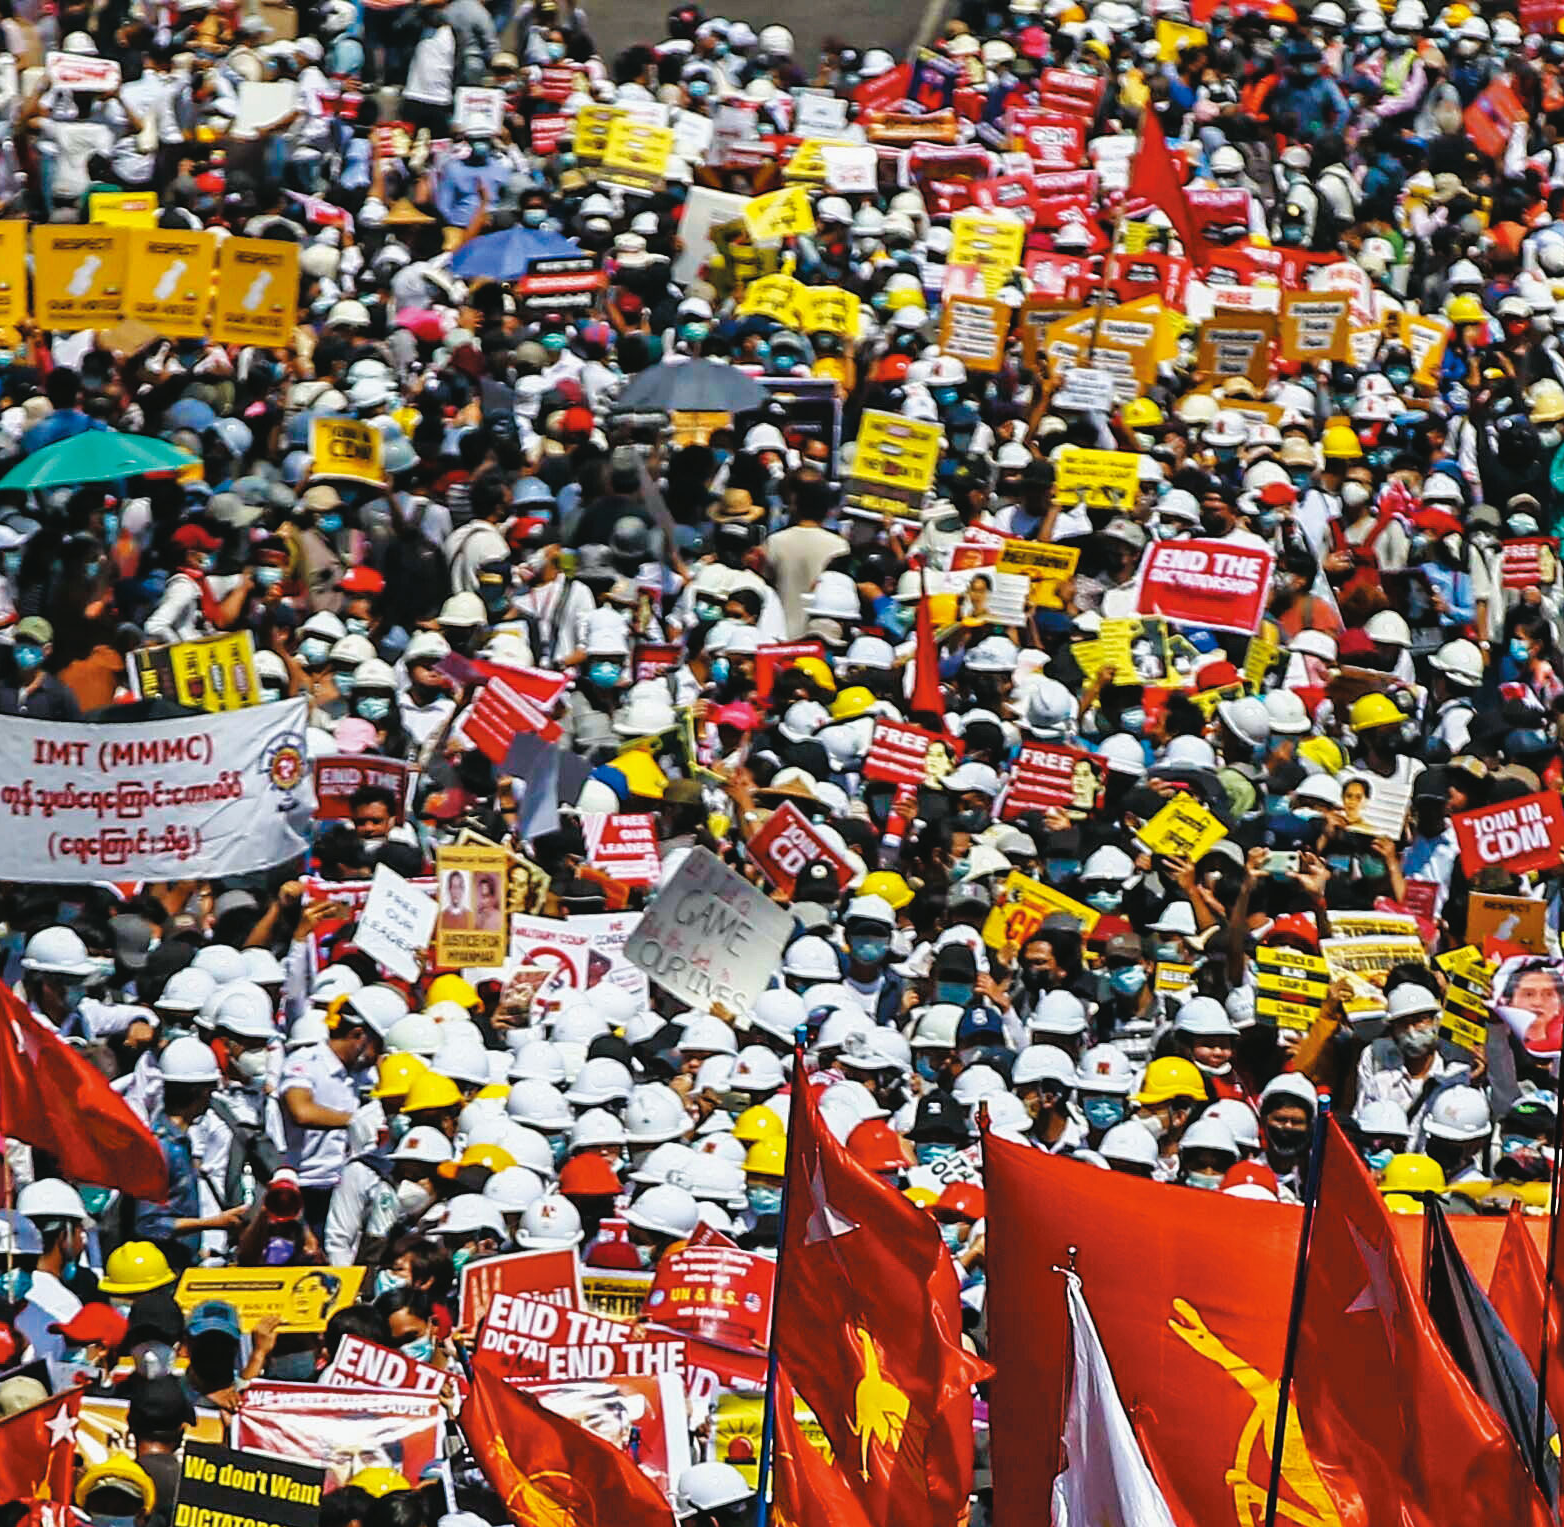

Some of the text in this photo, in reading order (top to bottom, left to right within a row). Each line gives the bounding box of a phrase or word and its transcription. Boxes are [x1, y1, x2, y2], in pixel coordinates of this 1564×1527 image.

[1154, 548, 1262, 581] END THE
[33, 732, 214, 773] IMT (MMMC)
[874, 725, 930, 752] FREE
[1019, 747, 1073, 771] FREE
[319, 767, 363, 785] END
[611, 813, 650, 828] FREE
[1517, 803, 1542, 825] IN
[618, 828, 652, 841] OUR
[1477, 815, 1554, 863] CDM”
[676, 889, 752, 959] GAME
[669, 1287, 740, 1306] UN & U.S.
[488, 1293, 632, 1347] END THE
[338, 1338, 408, 1390] END
[548, 1340, 687, 1380] END THE
[184, 1454, 321, 1507] We don't Want
